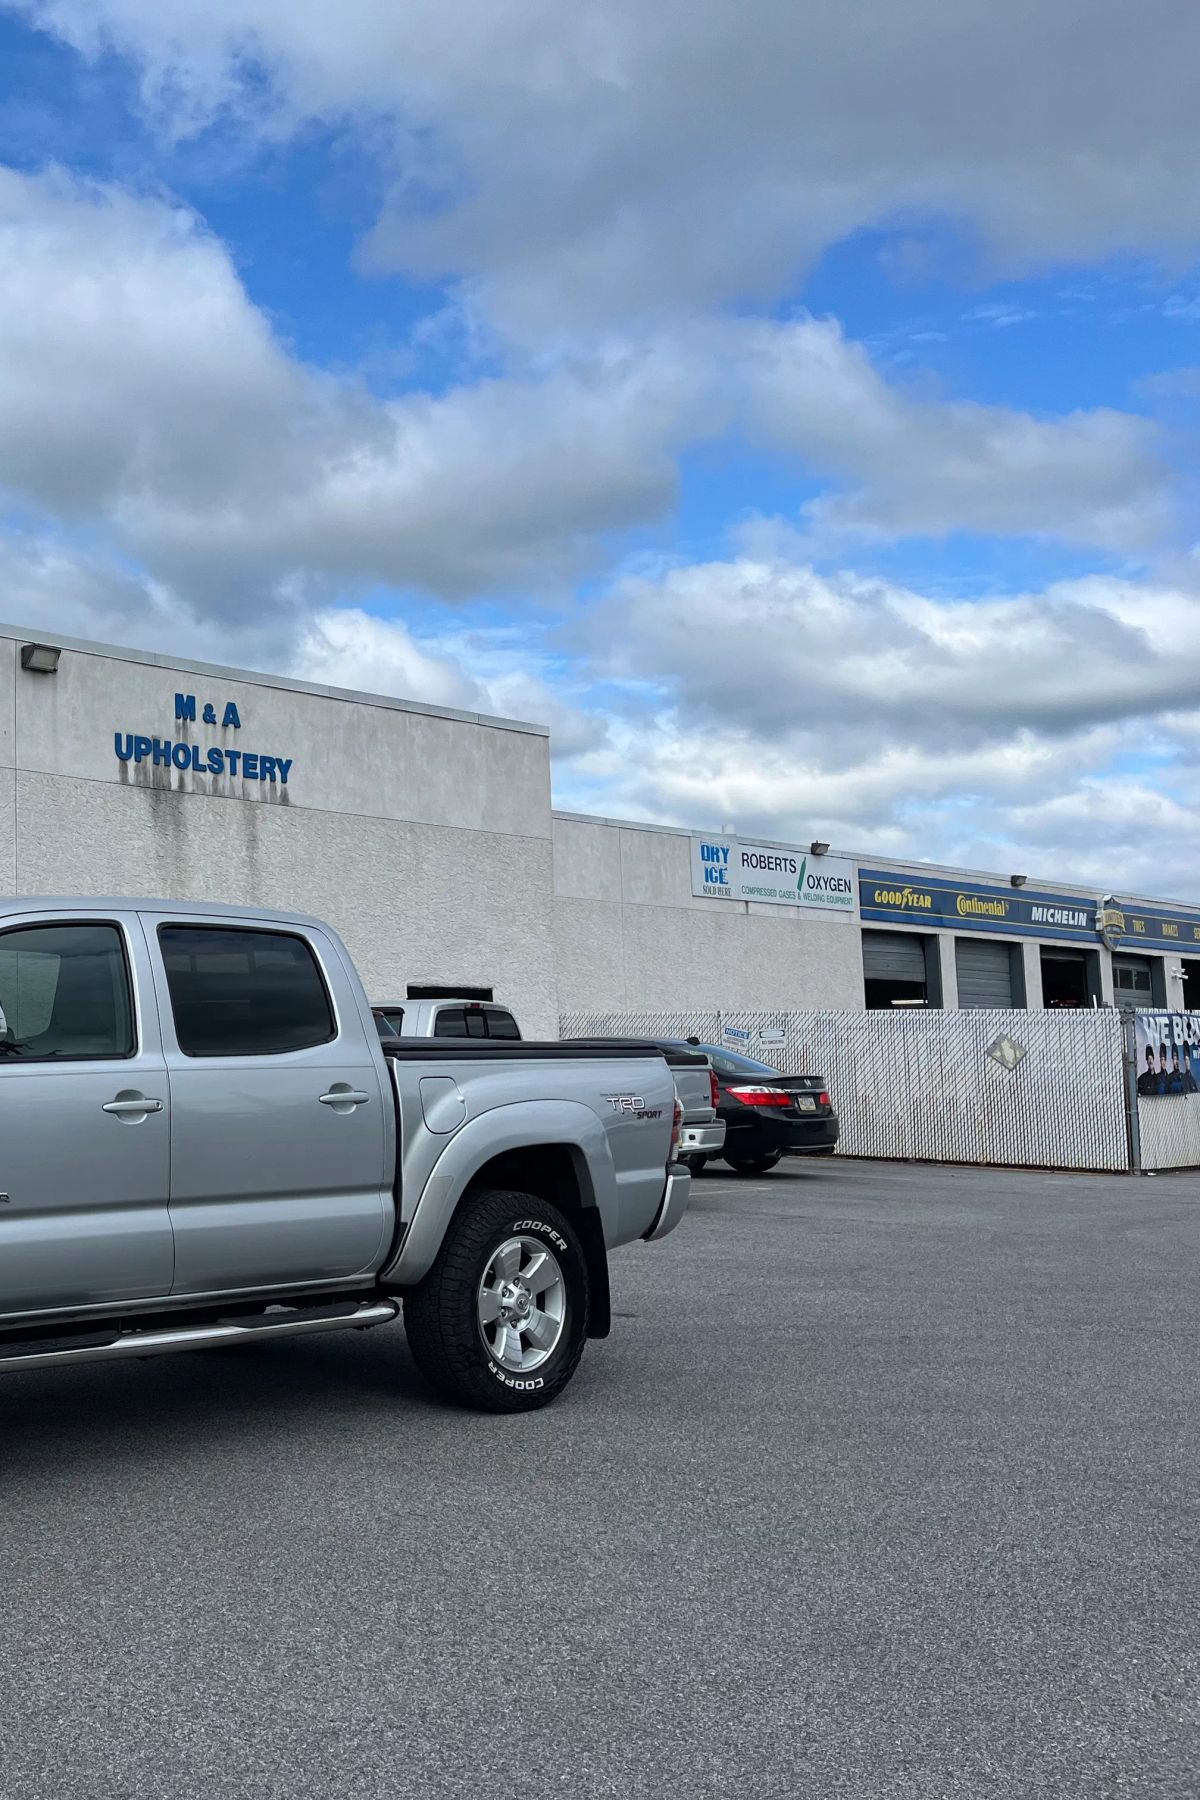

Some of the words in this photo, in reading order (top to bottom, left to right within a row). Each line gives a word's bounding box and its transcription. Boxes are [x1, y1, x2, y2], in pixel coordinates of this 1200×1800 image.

[174, 693, 196, 721] M
[202, 703, 216, 724] &
[222, 702, 241, 728] A
[114, 732, 293, 784] UPHOLSTERY
[700, 844, 730, 864] DRY
[741, 852, 797, 873] ROBERTS
[704, 867, 729, 884] ICE
[806, 874, 852, 893] OXYGEN
[702, 885, 716, 896] SOLD
[717, 886, 732, 897] HERE
[741, 885, 777, 898] COMPRESSED
[779, 889, 796, 900] GASES
[803, 892, 825, 903] WELDING
[826, 895, 854, 905] EQUIPMENT
[874, 889, 932, 908] GOODYEAR
[956, 895, 1006, 917] Continental
[1031, 906, 1087, 927] MICHELIN
[1142, 1016, 1171, 1047] WE
[606, 1096, 646, 1115] TRD
[637, 1110, 663, 1120] SPORT
[513, 1220, 568, 1251] COOPER
[487, 1361, 545, 1390] COOPER
